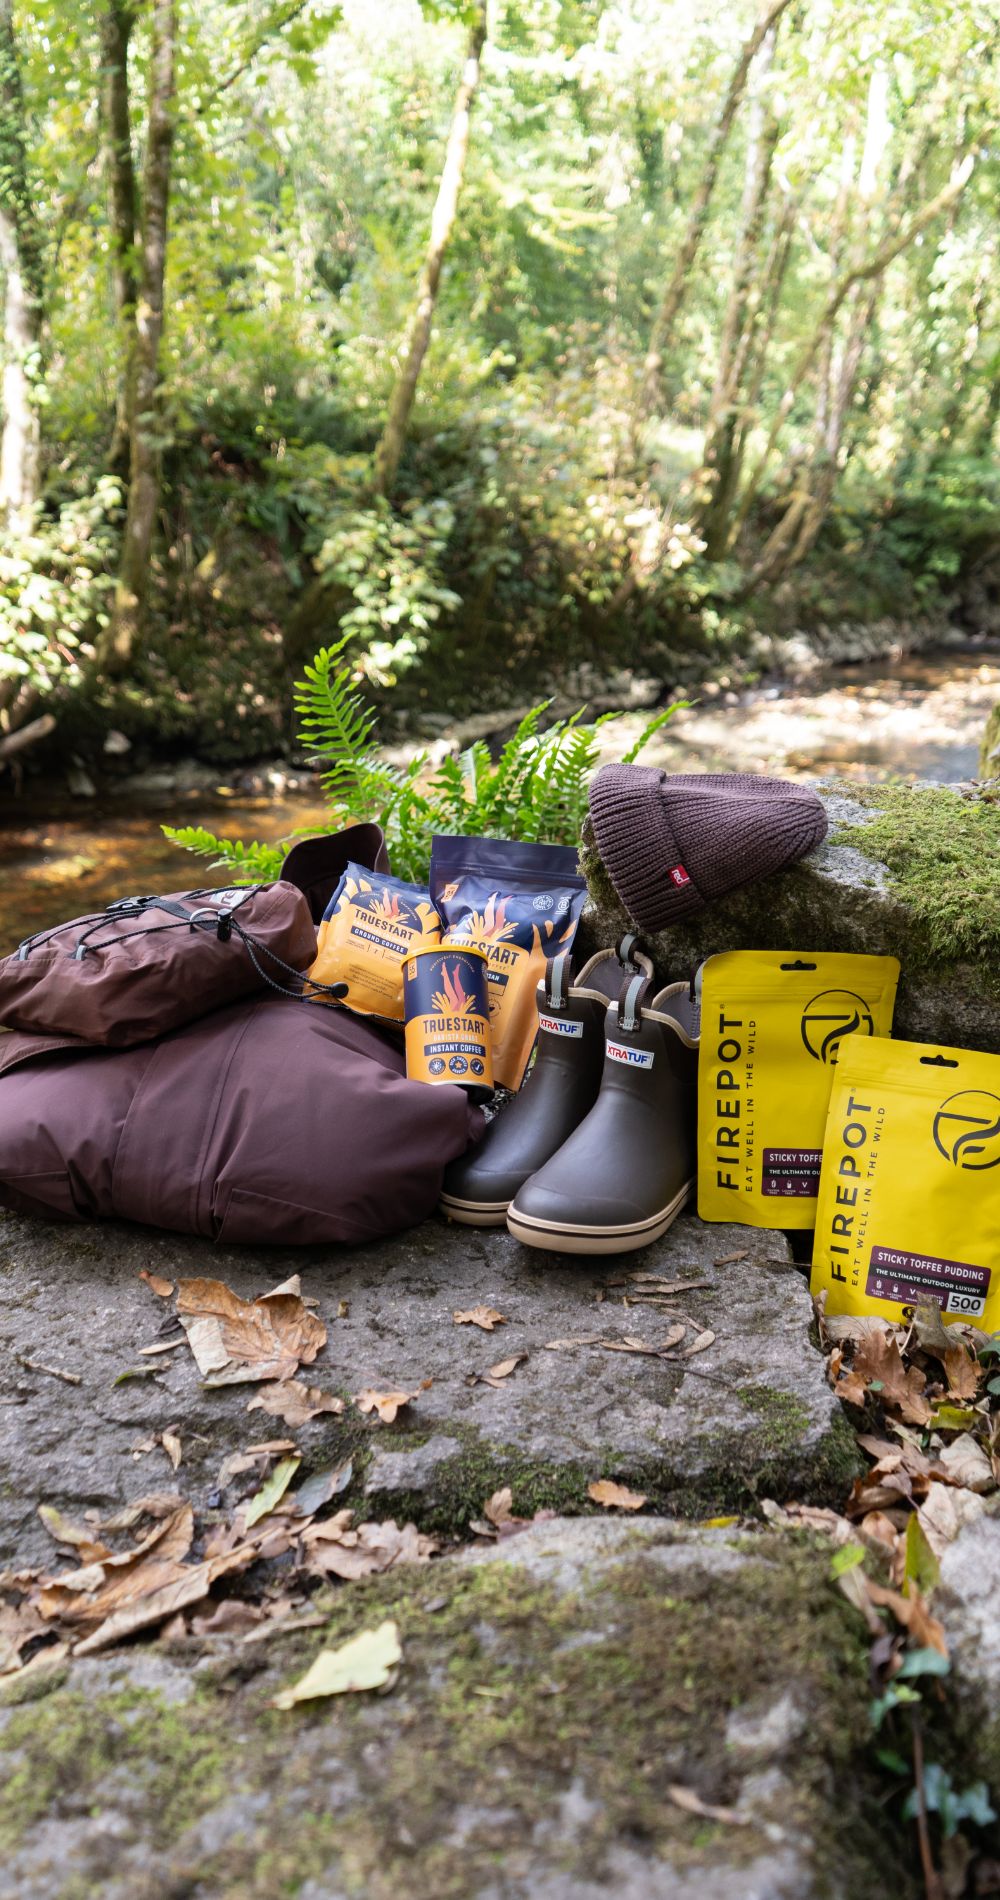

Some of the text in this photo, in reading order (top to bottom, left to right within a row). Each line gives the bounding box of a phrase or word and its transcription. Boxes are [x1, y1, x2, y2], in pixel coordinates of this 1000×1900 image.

[671, 869, 690, 884] red
[355, 908, 414, 940] TRUESTART
[354, 928, 380, 943] GROUND
[381, 940, 405, 953] COFFEE
[423, 1016, 485, 1035] TRUESTART
[540, 1018, 578, 1034] XTRATUF
[430, 1043, 482, 1054] INSTANT COFFEE
[607, 1045, 649, 1064] XTRATUF
[716, 1013, 743, 1191] FIREPOT
[745, 1020, 757, 1192] EAT WELL IN THE WILD
[769, 1153, 823, 1163] STICKY TOFFE
[830, 1096, 872, 1283] FIREPOT
[851, 1107, 886, 1286] EAT WELL IN THE WILD
[878, 1251, 984, 1281] STICKY TOFFEE PUDDING
[875, 1268, 981, 1294] THE ULTIMATE OUTDOOR LUXURY
[950, 1295, 981, 1311] 500
